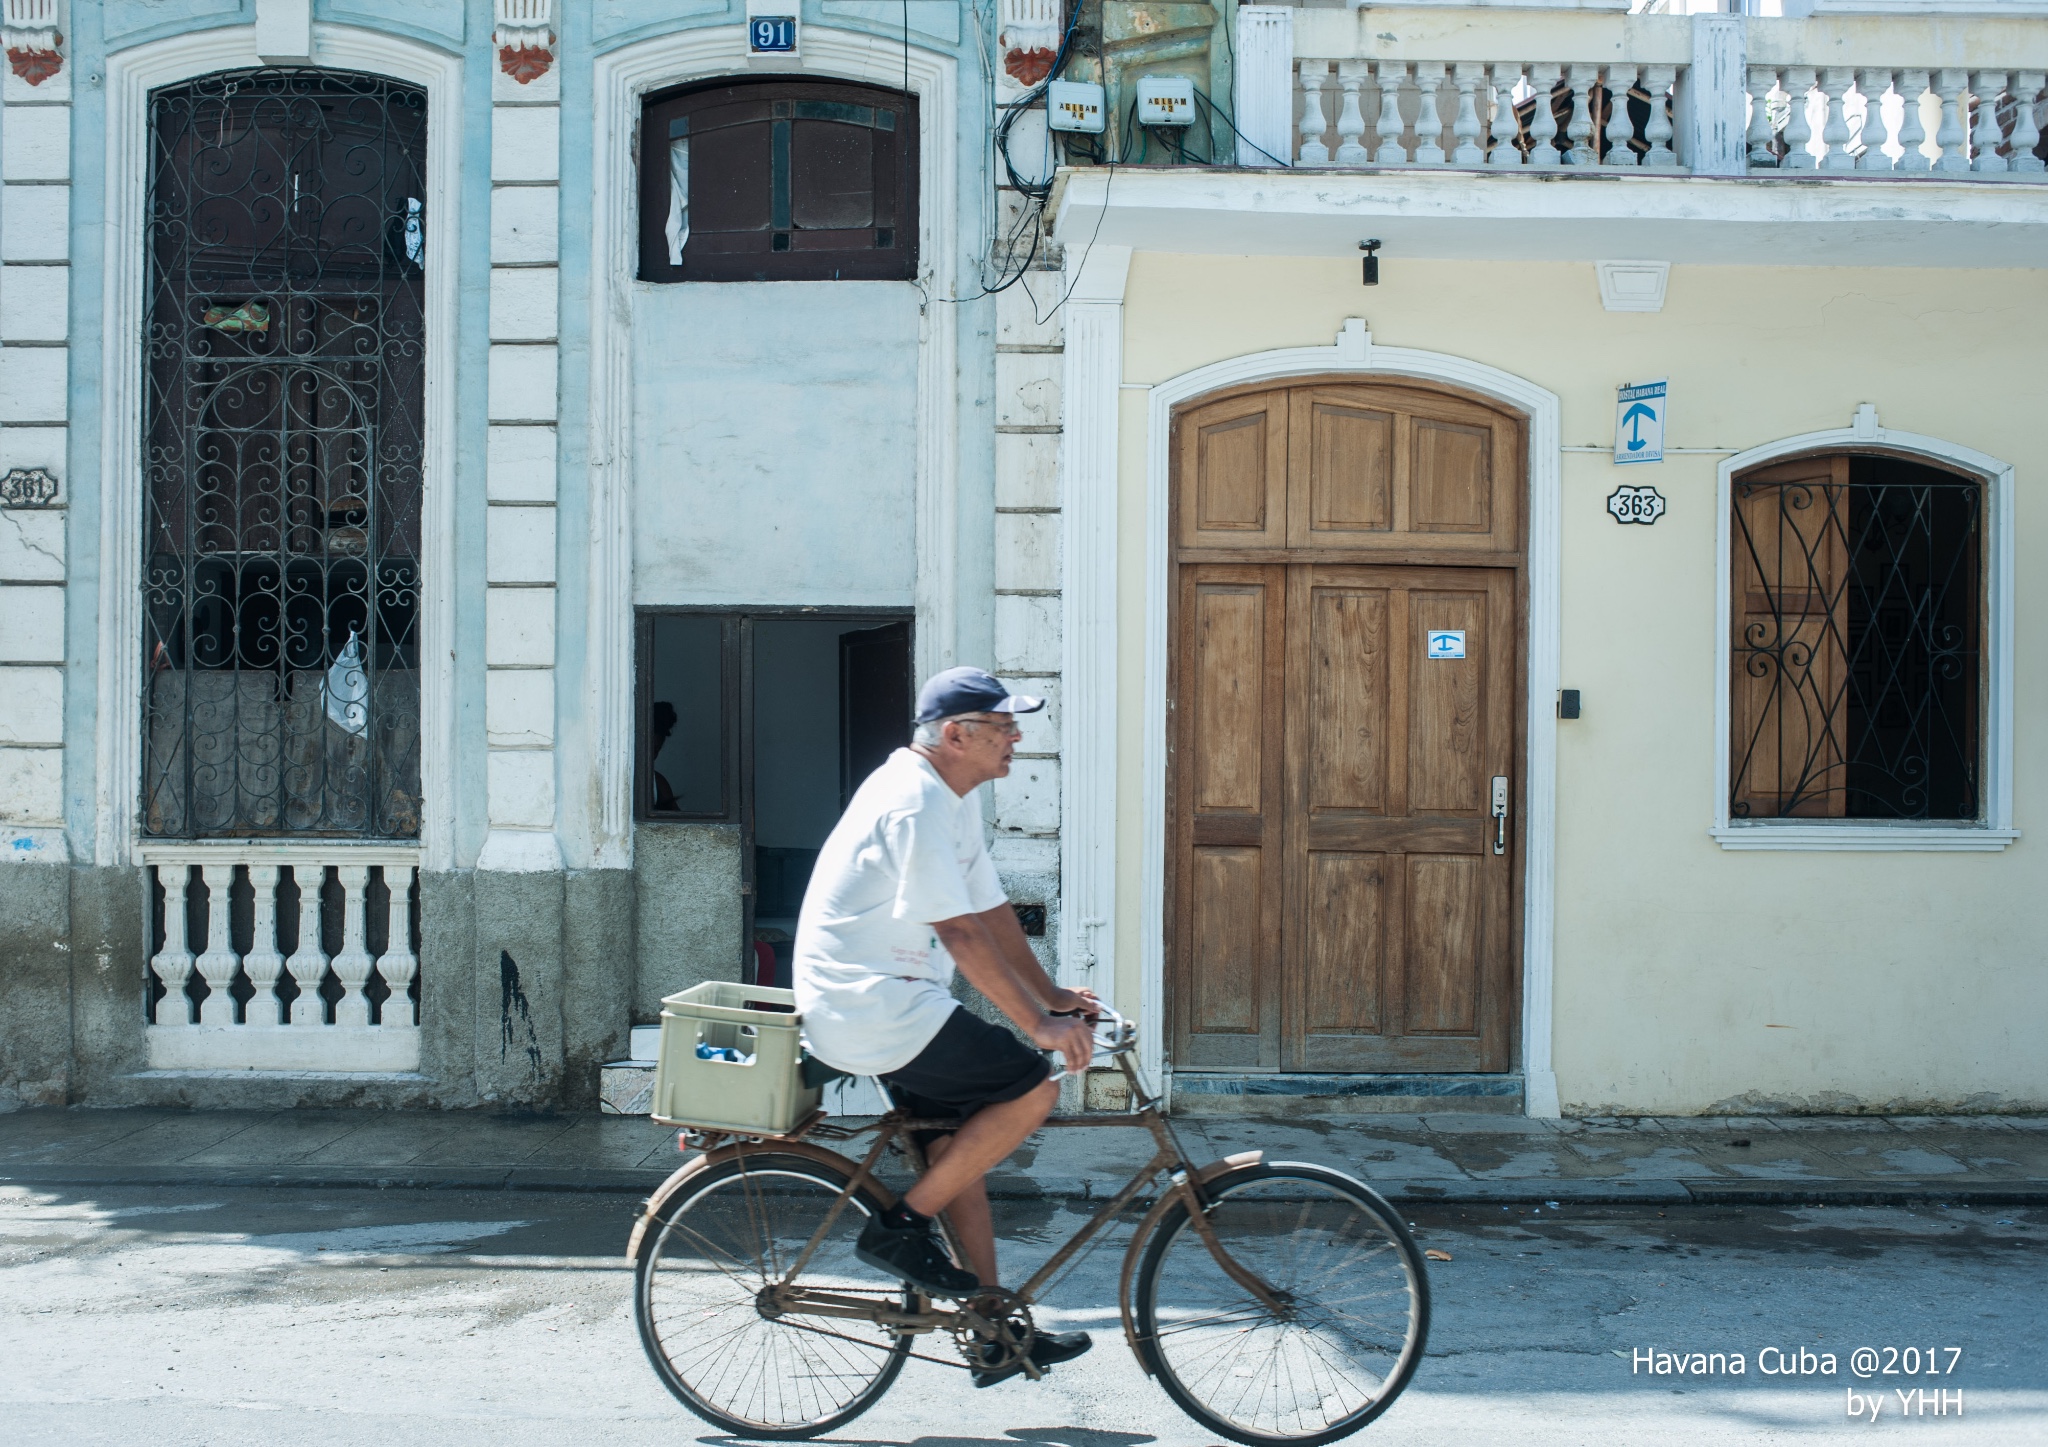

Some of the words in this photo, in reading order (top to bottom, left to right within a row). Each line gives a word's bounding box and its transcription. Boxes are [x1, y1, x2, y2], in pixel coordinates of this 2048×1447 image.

[758, 21, 787, 46] 91
[1635, 386, 1653, 398] HABANA
[10, 476, 44, 498] 361
[1618, 494, 1656, 516] 363
